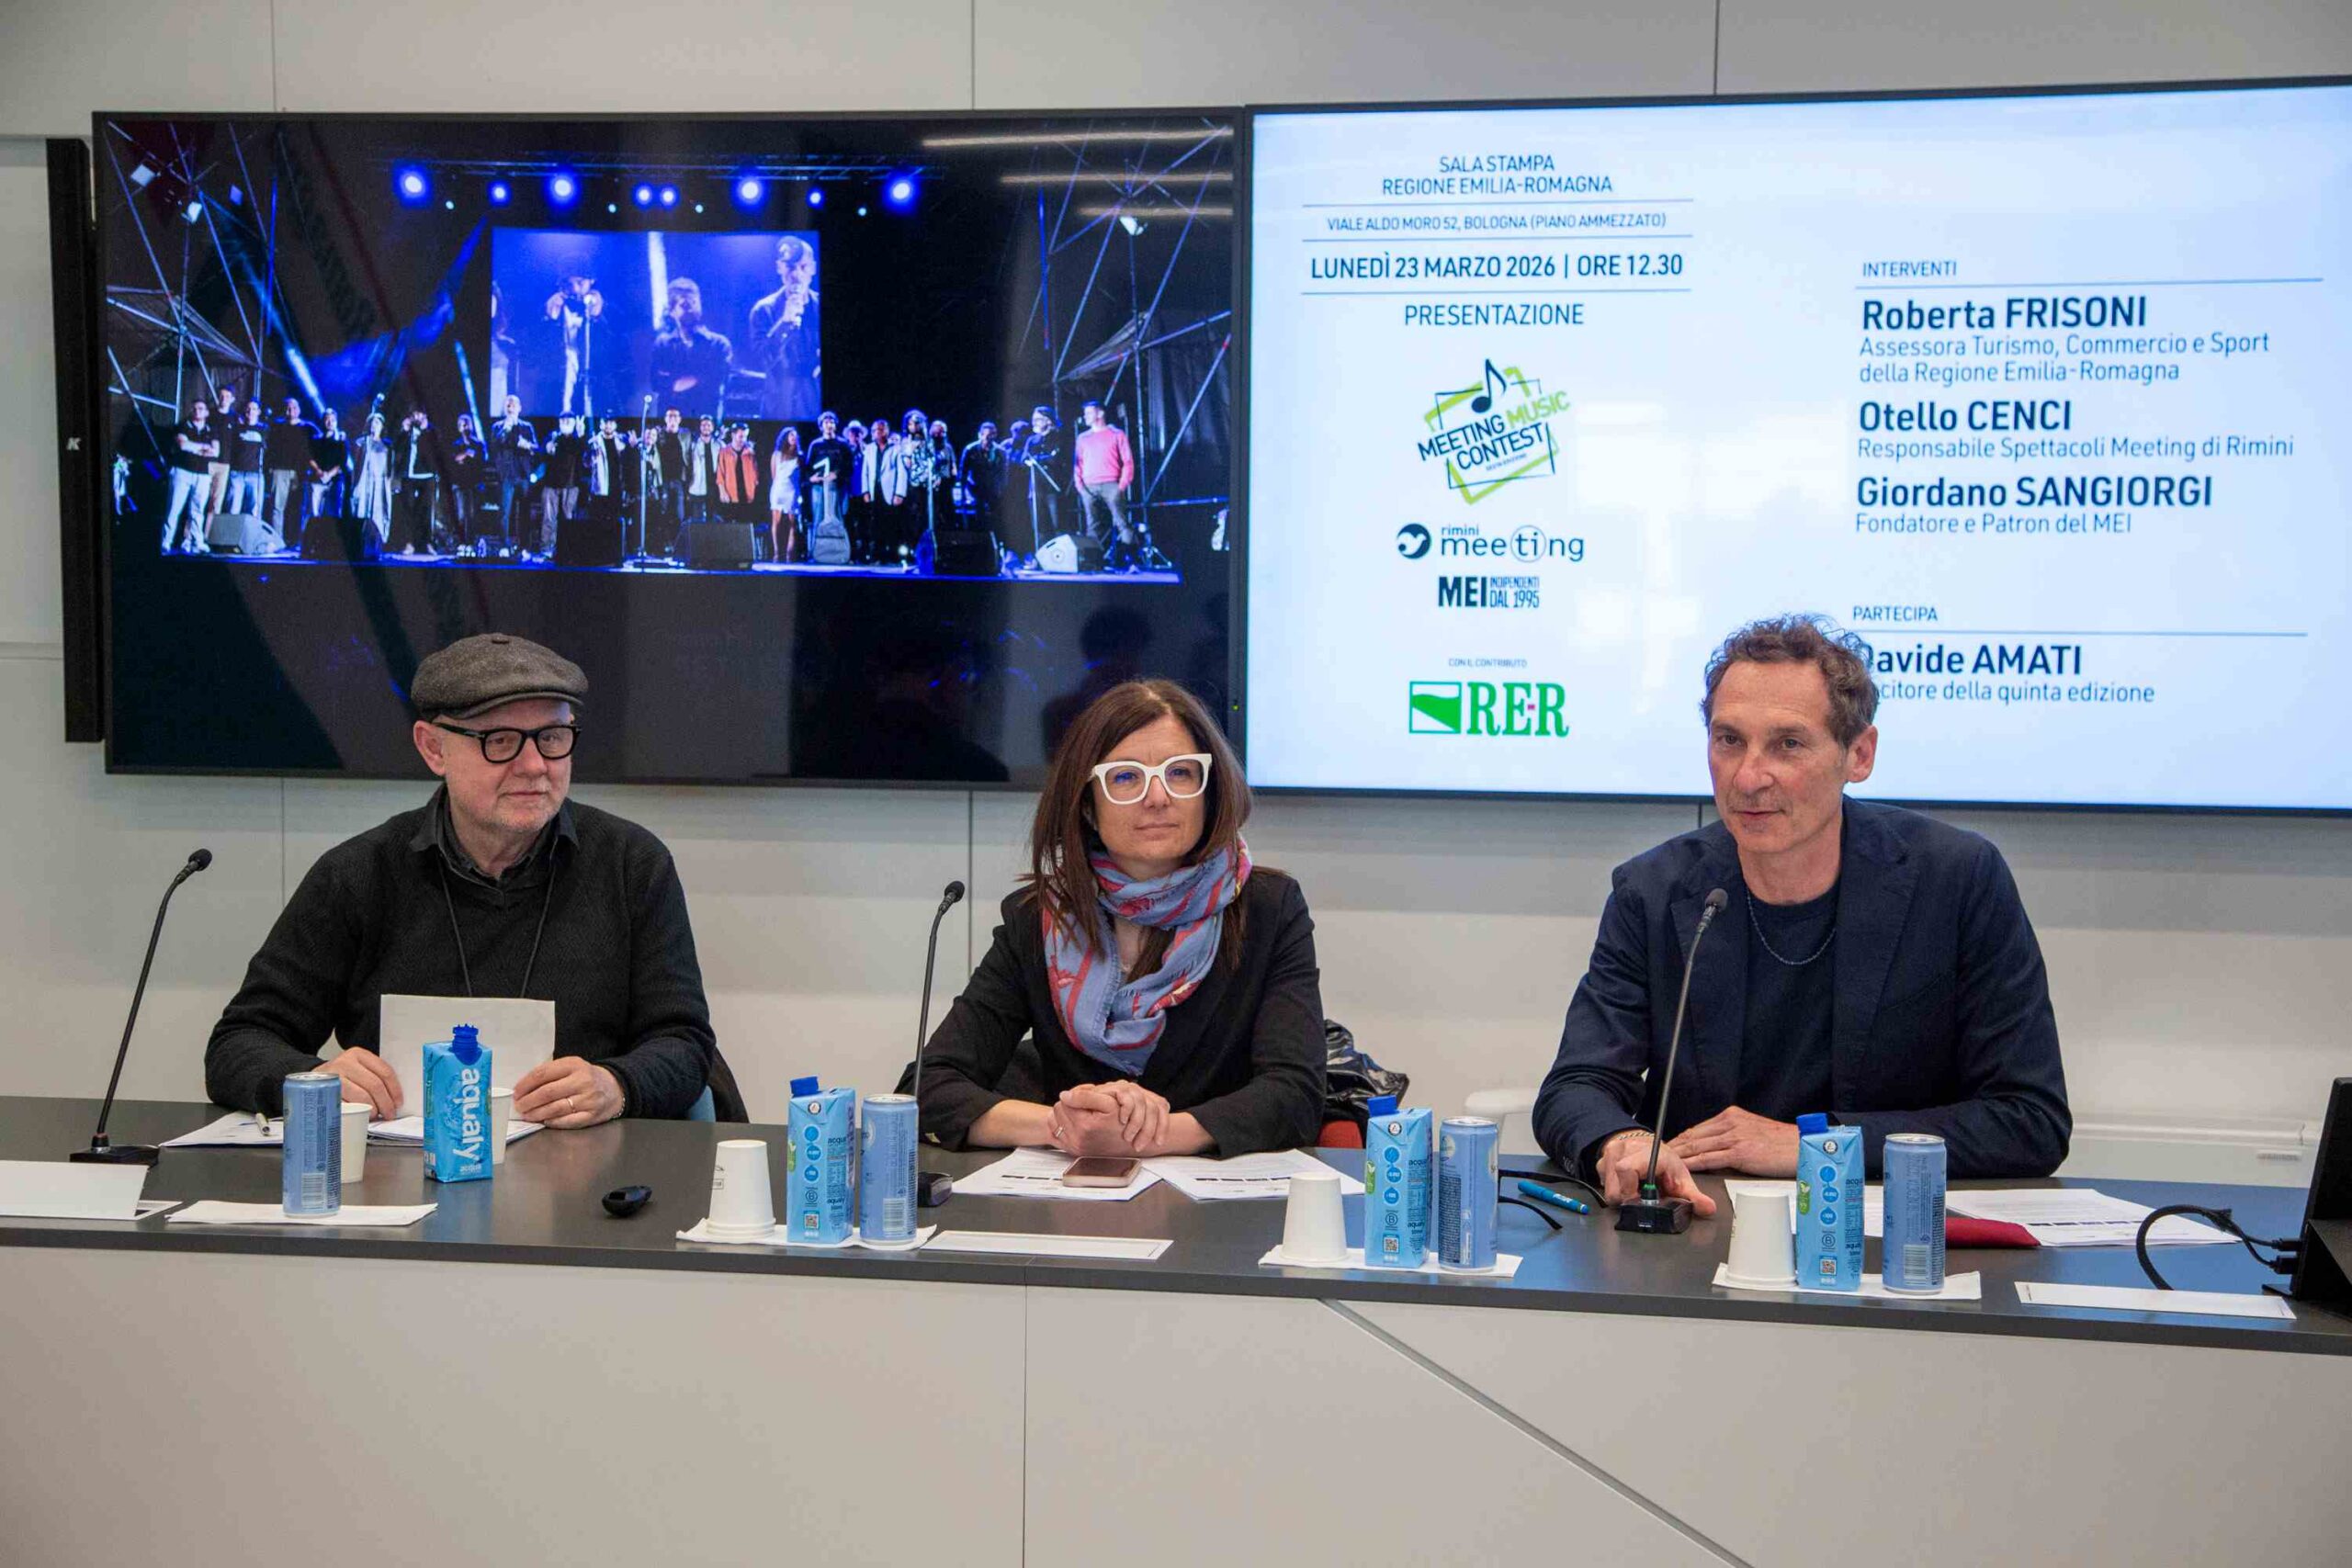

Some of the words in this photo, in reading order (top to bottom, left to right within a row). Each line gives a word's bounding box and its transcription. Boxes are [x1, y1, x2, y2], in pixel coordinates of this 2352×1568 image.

[1439, 155, 1485, 172] SALA
[1487, 155, 1555, 172] STAMPA
[1383, 178, 1455, 195] REGIONE
[1460, 176, 1612, 194] EMILIA-ROMAGNA
[1328, 217, 1363, 231] VIALE
[1366, 218, 1399, 231] ALDO
[1403, 217, 1441, 230] MORO
[1442, 217, 1462, 232] 52,
[1464, 216, 1528, 230] BOLOGNA
[1531, 216, 1576, 229] (PIANO
[1578, 213, 1666, 227] AMMEZZATO)
[1312, 252, 1389, 278] LUNEDÌ
[1396, 257, 1419, 277] 23
[1425, 256, 1501, 277] MARZO
[1507, 255, 1555, 276] 2026
[1577, 255, 1621, 276] ORE
[1627, 254, 1683, 276] 12.30
[1863, 261, 1956, 276] INTERVENTI
[1406, 303, 1583, 326] PRESENTAZIONE
[1863, 299, 1995, 330] Roberta
[2007, 296, 2146, 328] FRISONI
[1860, 337, 1966, 356] Assessora
[1973, 334, 2060, 356] Turismo,
[2066, 334, 2187, 355] Commercio
[2193, 338, 2204, 353] e
[2211, 332, 2268, 356] Sport
[1860, 363, 1908, 382] della
[1916, 362, 1998, 388] Regione
[2005, 360, 2179, 386] Emilia-Romagna
[1418, 414, 1505, 461] MEETING
[1506, 390, 1570, 429] MUSIC
[1860, 401, 1958, 432] Otello
[1968, 400, 2071, 431] CENCI
[1456, 422, 1544, 470] CONTEST
[1858, 438, 1996, 462] Responsabile
[2001, 436, 2104, 462] Spettacoli
[2111, 437, 2196, 462] Meeting
[2202, 436, 2220, 457] di
[2227, 435, 2293, 456] Rimini
[1858, 477, 2007, 507] Giordano
[2016, 476, 2211, 507] SANGIORGI
[1441, 525, 1479, 536] rimini
[1856, 513, 1959, 533] Fondatore
[1964, 519, 1975, 533] e
[1983, 513, 2049, 533] Patron
[2056, 513, 2086, 533] del
[2094, 513, 2131, 533] MEI
[1441, 532, 1584, 562] meeting
[1439, 576, 1487, 607] MEI
[1489, 591, 1509, 607] DAL
[1513, 591, 1540, 607] 1995
[1853, 606, 1938, 621] PARTECIPA
[1972, 645, 2081, 675] AMATI
[1881, 680, 1937, 699] citore
[1943, 680, 1992, 700] della
[1998, 683, 2061, 705] quinta
[2068, 682, 2154, 703] edizione
[452, 1068, 484, 1161] aqualy
